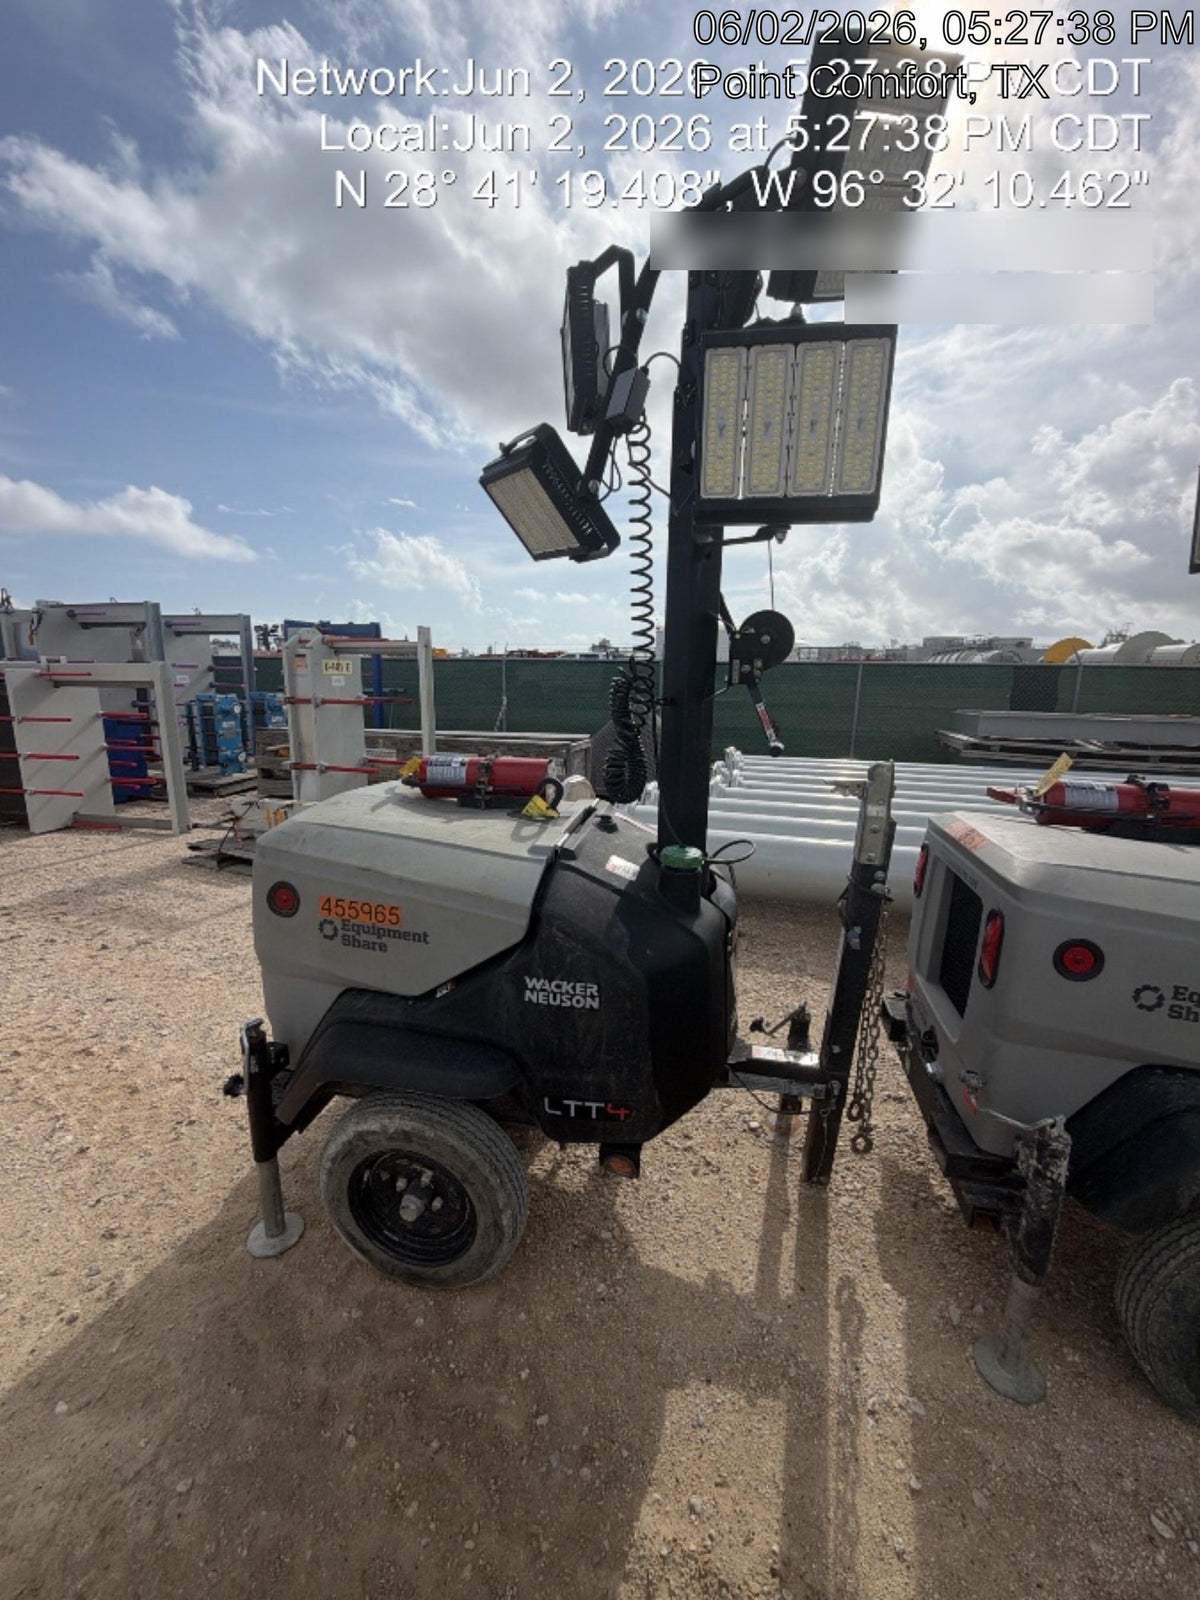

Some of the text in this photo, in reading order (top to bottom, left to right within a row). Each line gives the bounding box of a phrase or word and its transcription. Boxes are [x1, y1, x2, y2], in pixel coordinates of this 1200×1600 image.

[320, 896, 401, 926] 455965
[341, 919, 430, 945] Equipment
[341, 933, 388, 953] Share
[524, 976, 599, 997] WACKER
[524, 989, 600, 1009] NEUSON
[543, 1096, 631, 1121] LTT4
